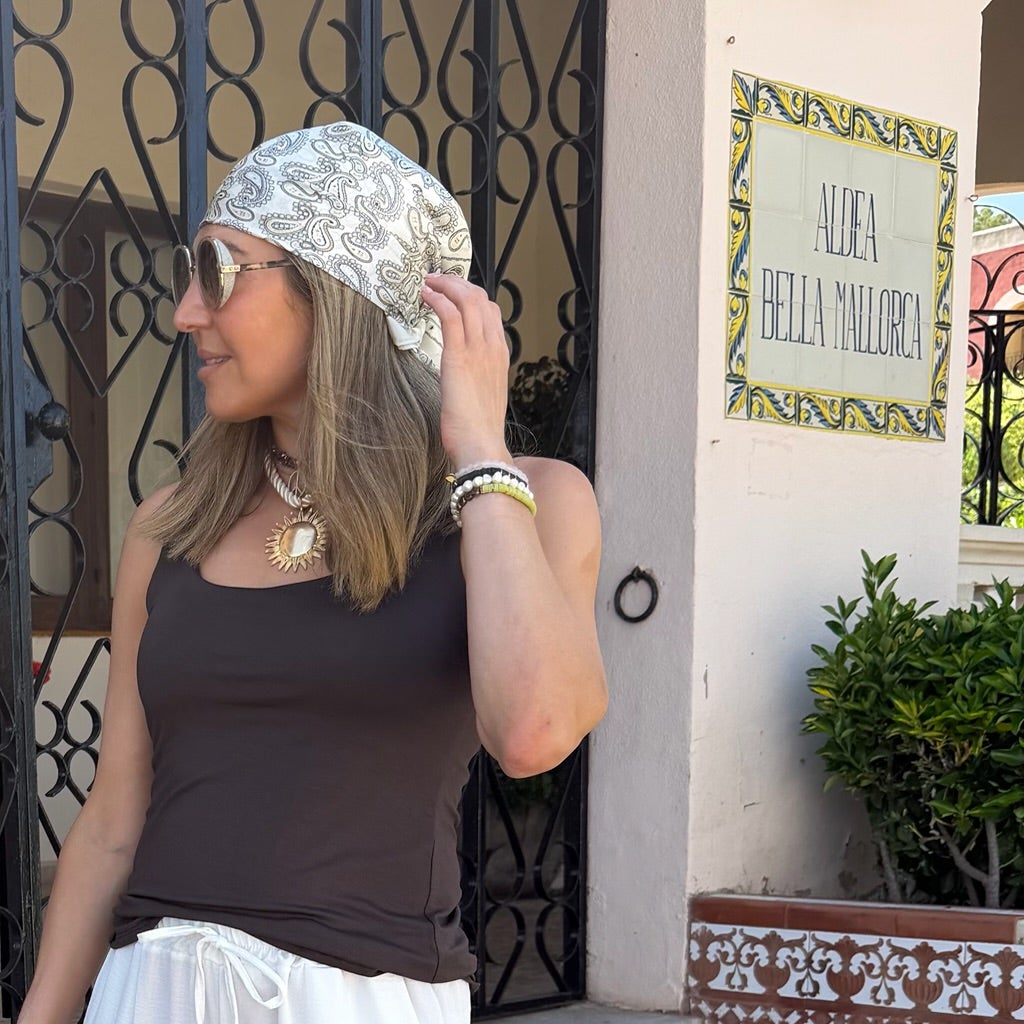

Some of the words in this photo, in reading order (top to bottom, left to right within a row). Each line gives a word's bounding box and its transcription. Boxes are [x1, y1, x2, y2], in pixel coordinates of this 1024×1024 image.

[813, 182, 878, 264] ALDEA
[760, 268, 826, 348] BELLA
[834, 281, 923, 361] MALLORCA
